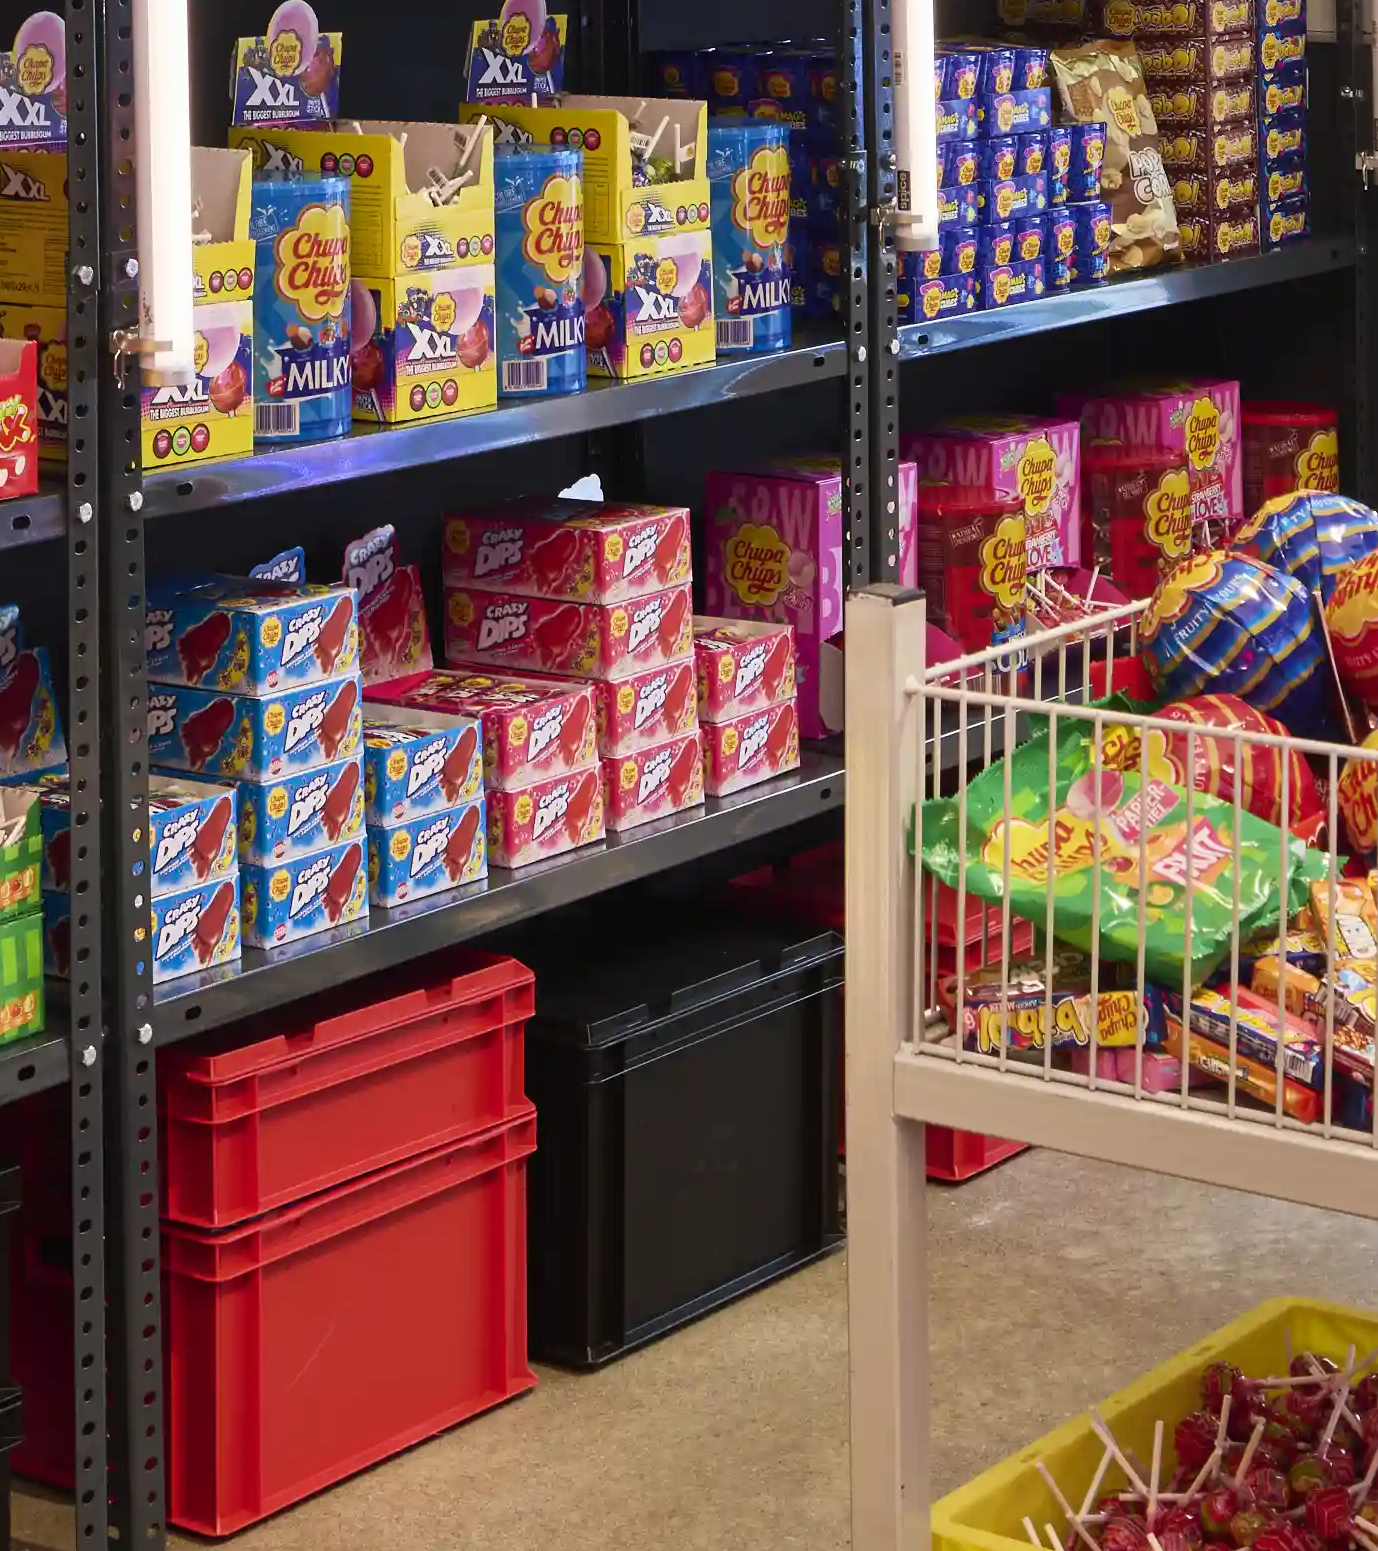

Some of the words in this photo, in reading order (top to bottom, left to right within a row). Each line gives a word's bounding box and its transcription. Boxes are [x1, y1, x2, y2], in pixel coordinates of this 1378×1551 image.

[478, 47, 527, 84] XXL
[246, 66, 300, 107] XXL
[899, 171, 911, 210] spice
[743, 279, 792, 309] MILKY
[287, 354, 350, 392] MILKY
[1194, 499, 1217, 517] LOVE
[348, 552, 394, 594] DIPS
[291, 605, 321, 630] CRAZY
[487, 602, 527, 618] CRAZY
[1174, 605, 1209, 644] FRUITY
[283, 618, 321, 666] DIPS
[478, 614, 529, 651] DIPS
[165, 893, 201, 921] CRAZY
[156, 906, 199, 959] DIPS
